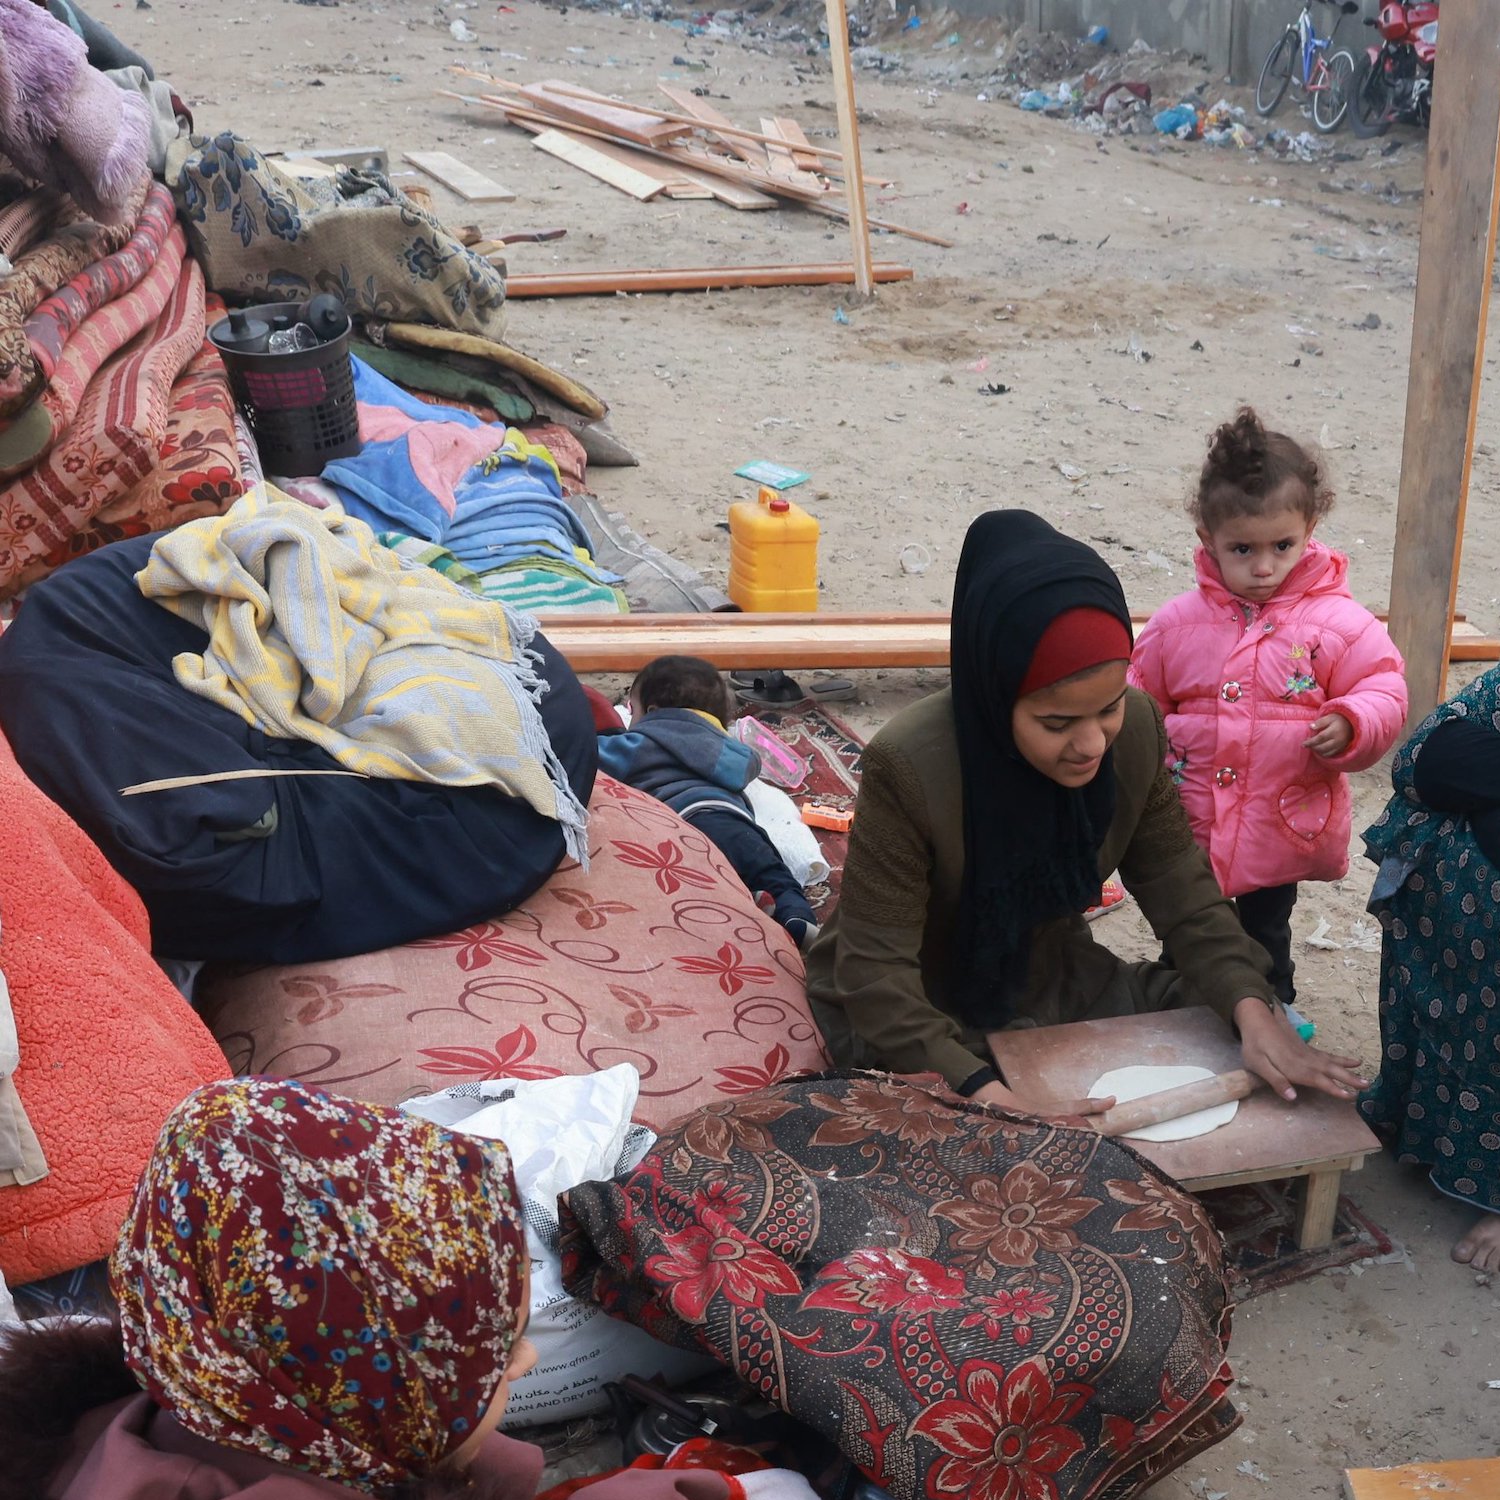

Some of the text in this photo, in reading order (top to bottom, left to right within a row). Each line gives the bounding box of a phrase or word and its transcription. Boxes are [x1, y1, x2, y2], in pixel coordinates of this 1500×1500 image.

[540, 1348, 601, 1375] www.qfm.qa
[504, 1403, 534, 1415] LEAN
[535, 1398, 561, 1409] AND
[563, 1393, 584, 1404] DRY
